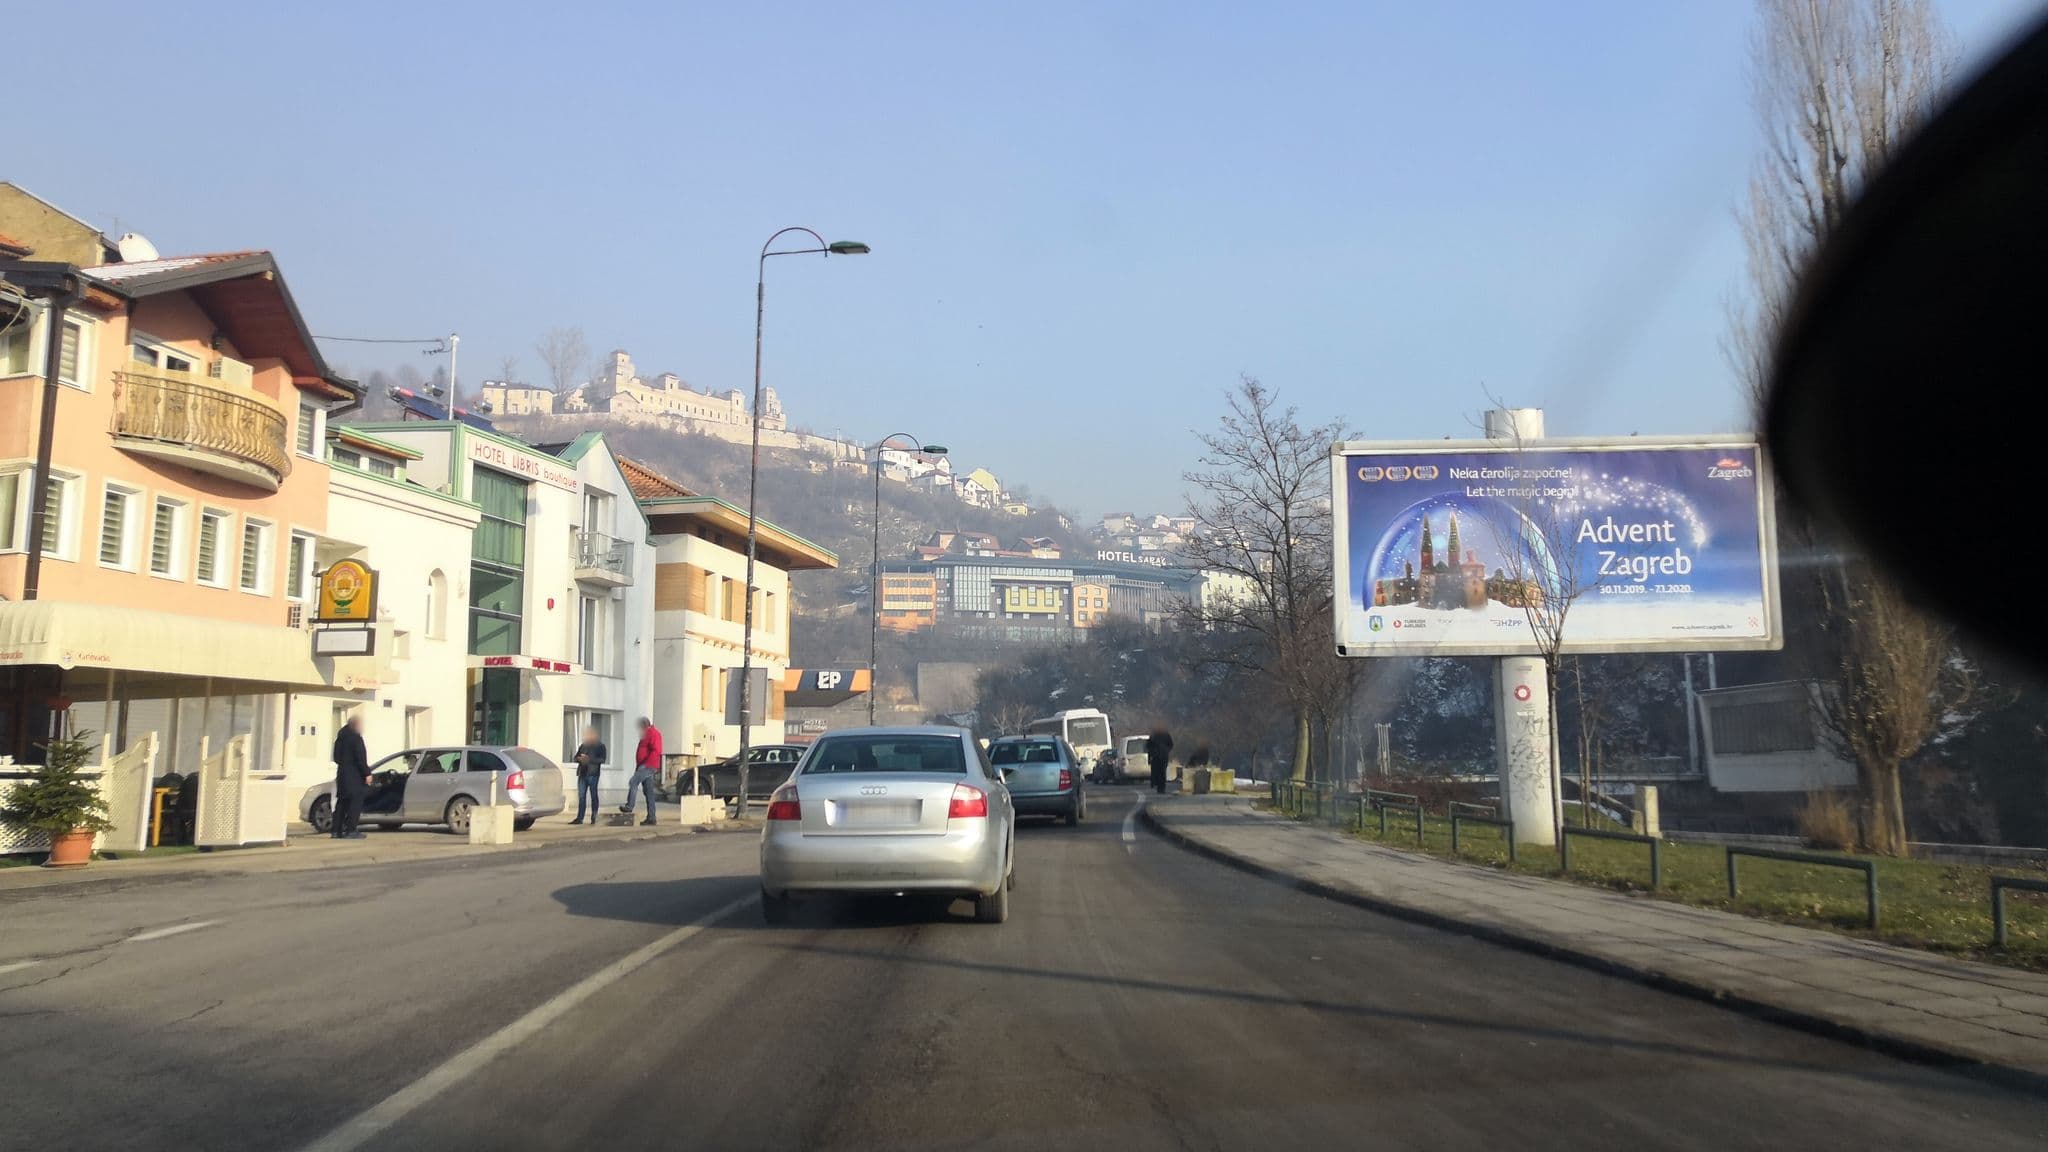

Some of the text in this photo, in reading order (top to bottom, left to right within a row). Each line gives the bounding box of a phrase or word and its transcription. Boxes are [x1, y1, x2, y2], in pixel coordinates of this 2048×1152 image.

[474, 441, 577, 489] HOTEL LIBRIS boutique
[1707, 465, 1752, 480] Zagreb
[1450, 466, 1573, 481] Neka čarolija započne!
[1466, 486, 1485, 497] Let
[1487, 485, 1505, 497] the
[1507, 486, 1541, 499] magic
[1577, 516, 1676, 543] Advent
[1097, 550, 1137, 563] HOTEL
[1598, 547, 1692, 583] Zagreb
